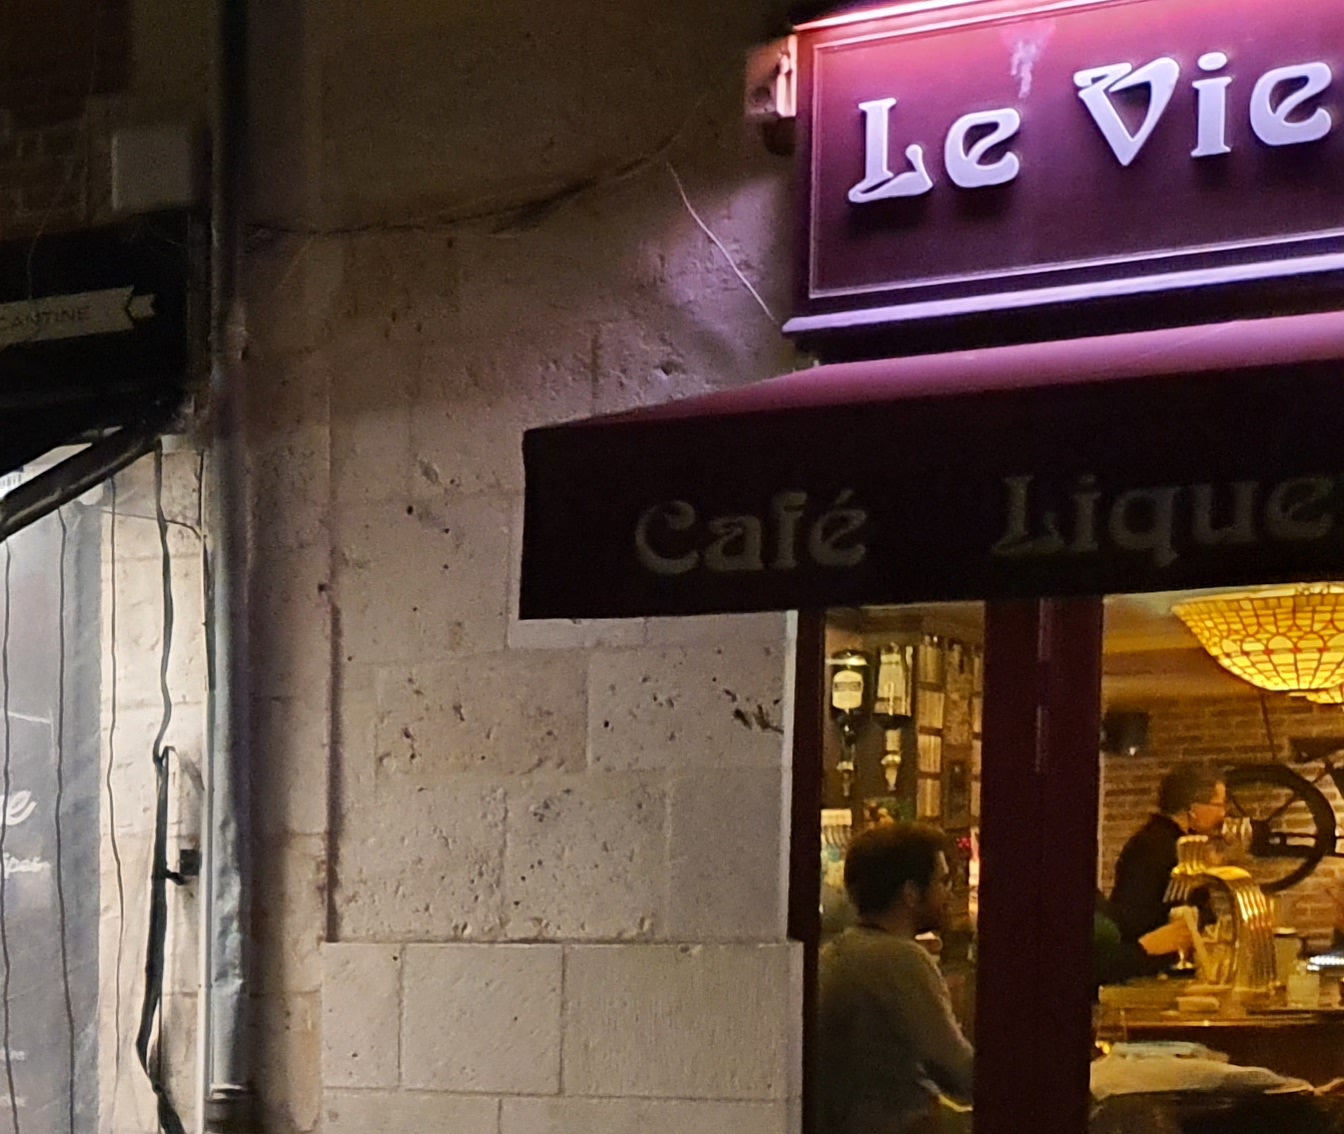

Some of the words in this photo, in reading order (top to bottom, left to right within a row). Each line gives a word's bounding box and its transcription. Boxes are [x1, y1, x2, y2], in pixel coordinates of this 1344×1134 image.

[847, 96, 1023, 203] Le
[1073, 51, 1333, 166] Vie
[634, 487, 868, 576] Café
